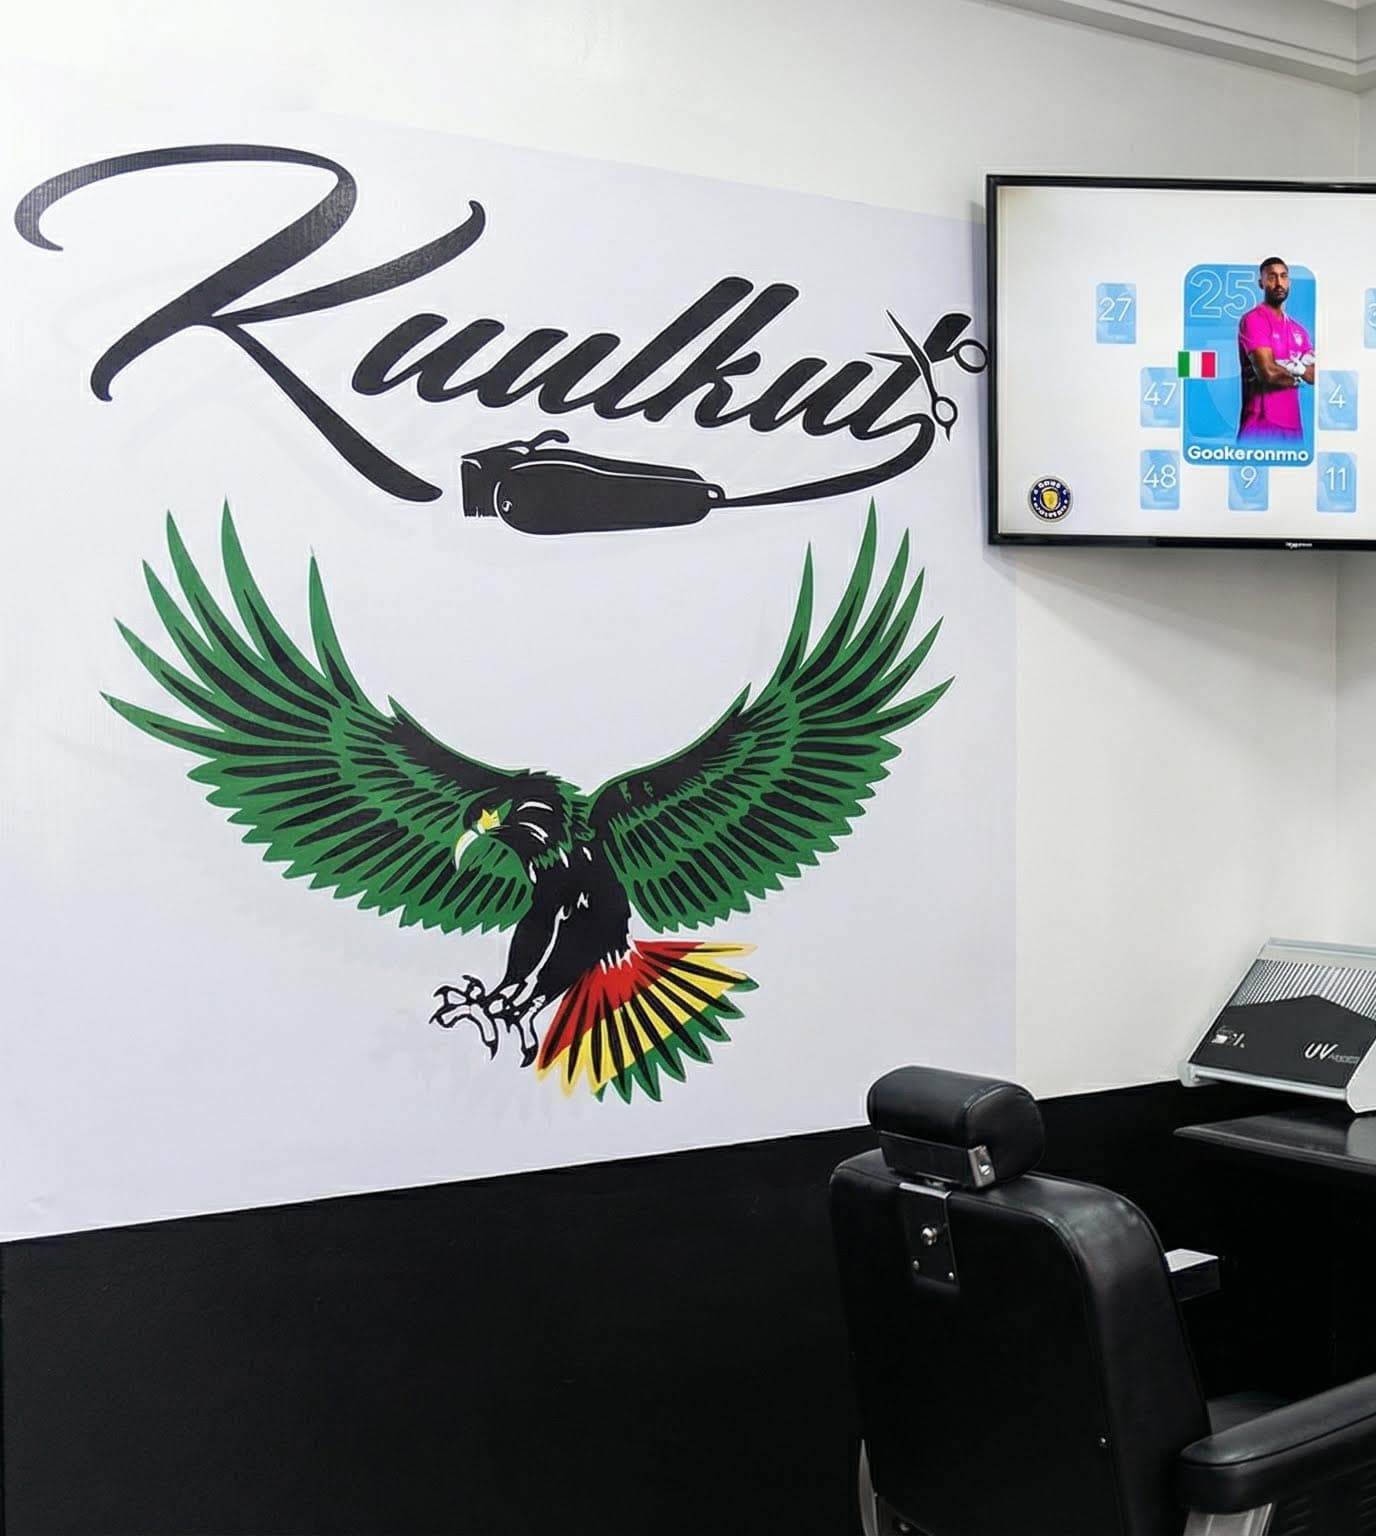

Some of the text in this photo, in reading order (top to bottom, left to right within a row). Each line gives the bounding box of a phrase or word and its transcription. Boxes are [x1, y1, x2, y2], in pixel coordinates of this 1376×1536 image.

[1189, 269, 1257, 319] 25
[1099, 296, 1132, 322] 27
[1143, 381, 1177, 406] 47
[1328, 383, 1347, 409] 4
[1142, 463, 1177, 489] 48
[1240, 465, 1257, 489] 9
[1325, 466, 1348, 491] 11
[1304, 1043, 1339, 1060] UV
